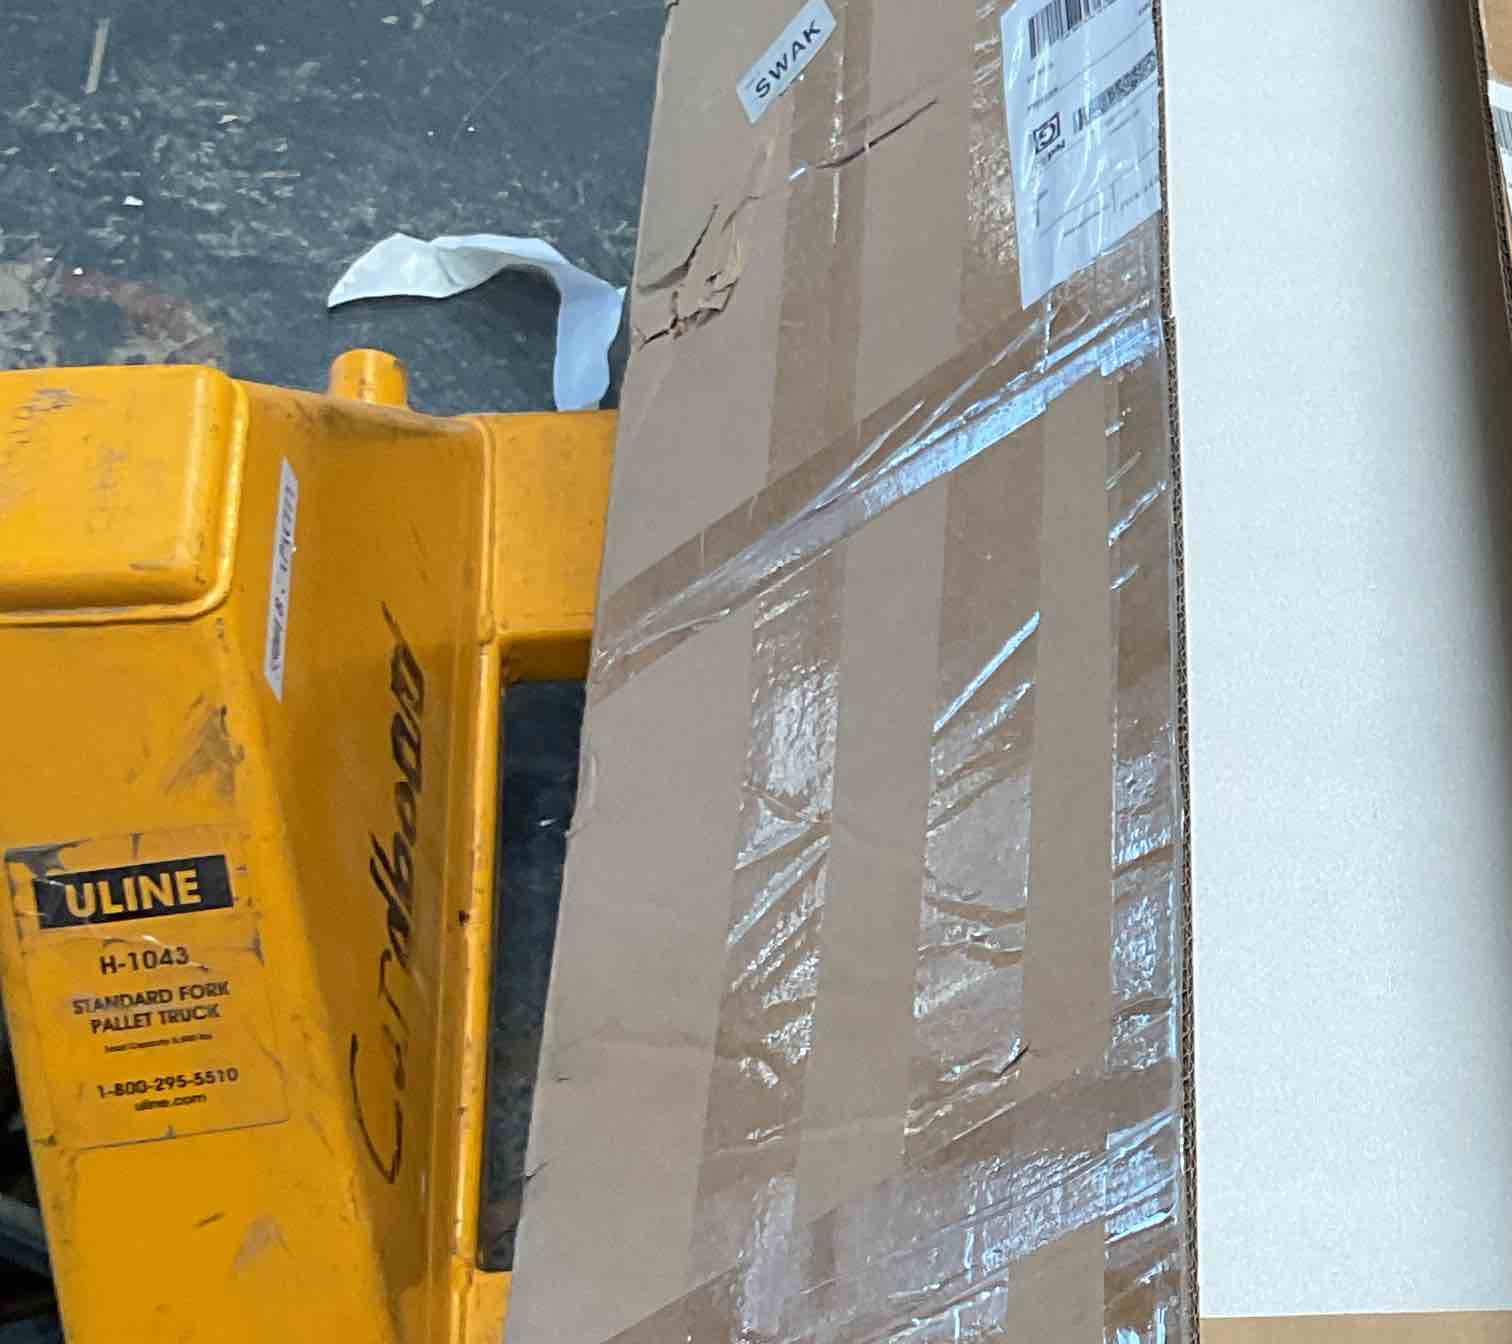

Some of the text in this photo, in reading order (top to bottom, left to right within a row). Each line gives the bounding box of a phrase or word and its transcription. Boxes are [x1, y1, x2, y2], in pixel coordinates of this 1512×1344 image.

[755, 18, 822, 98] SWAK
[64, 868, 202, 918] ULINE
[99, 945, 190, 975] H-1043
[72, 980, 231, 1015] STANDARD FORK
[89, 1002, 222, 1035] PALLET TRUCK
[96, 1067, 240, 1100] 1-800-295-5510
[133, 1093, 208, 1112] uline.com
